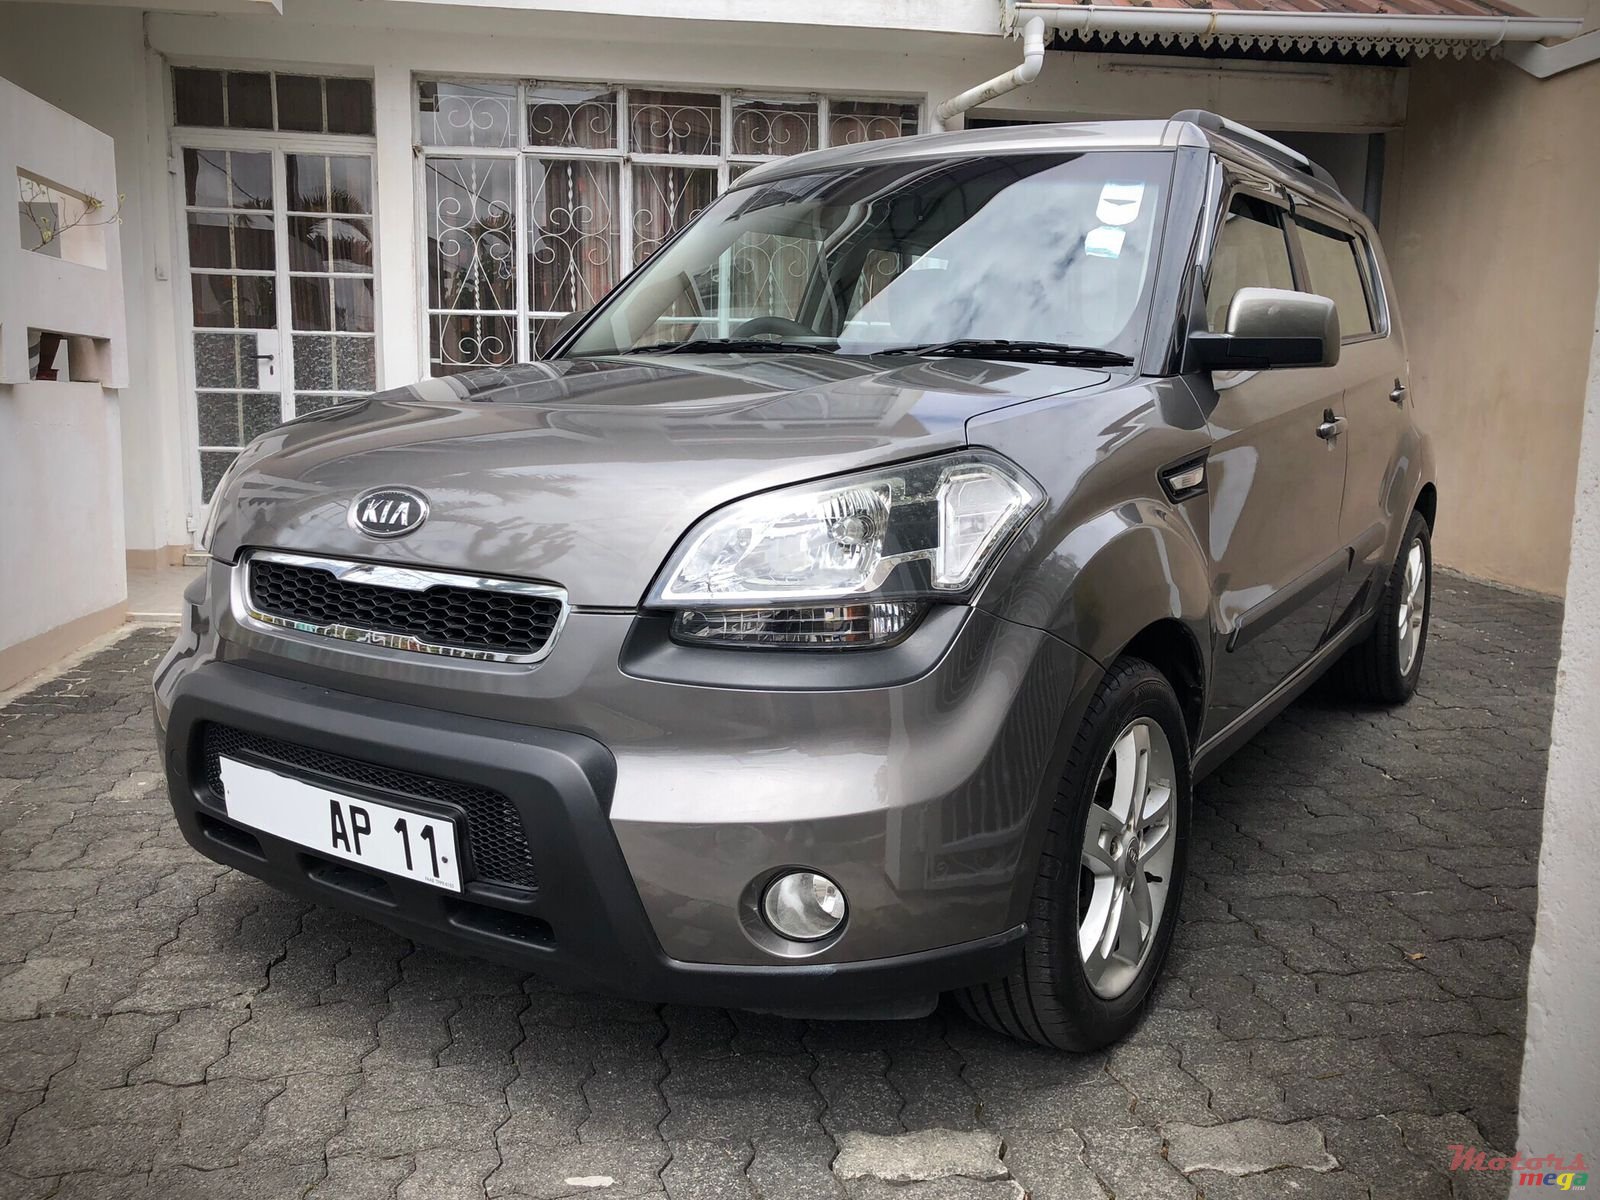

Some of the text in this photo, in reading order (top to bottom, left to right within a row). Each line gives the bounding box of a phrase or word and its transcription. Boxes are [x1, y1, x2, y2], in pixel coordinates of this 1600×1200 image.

[362, 499, 410, 526] KIA
[329, 799, 440, 879] AP 11
